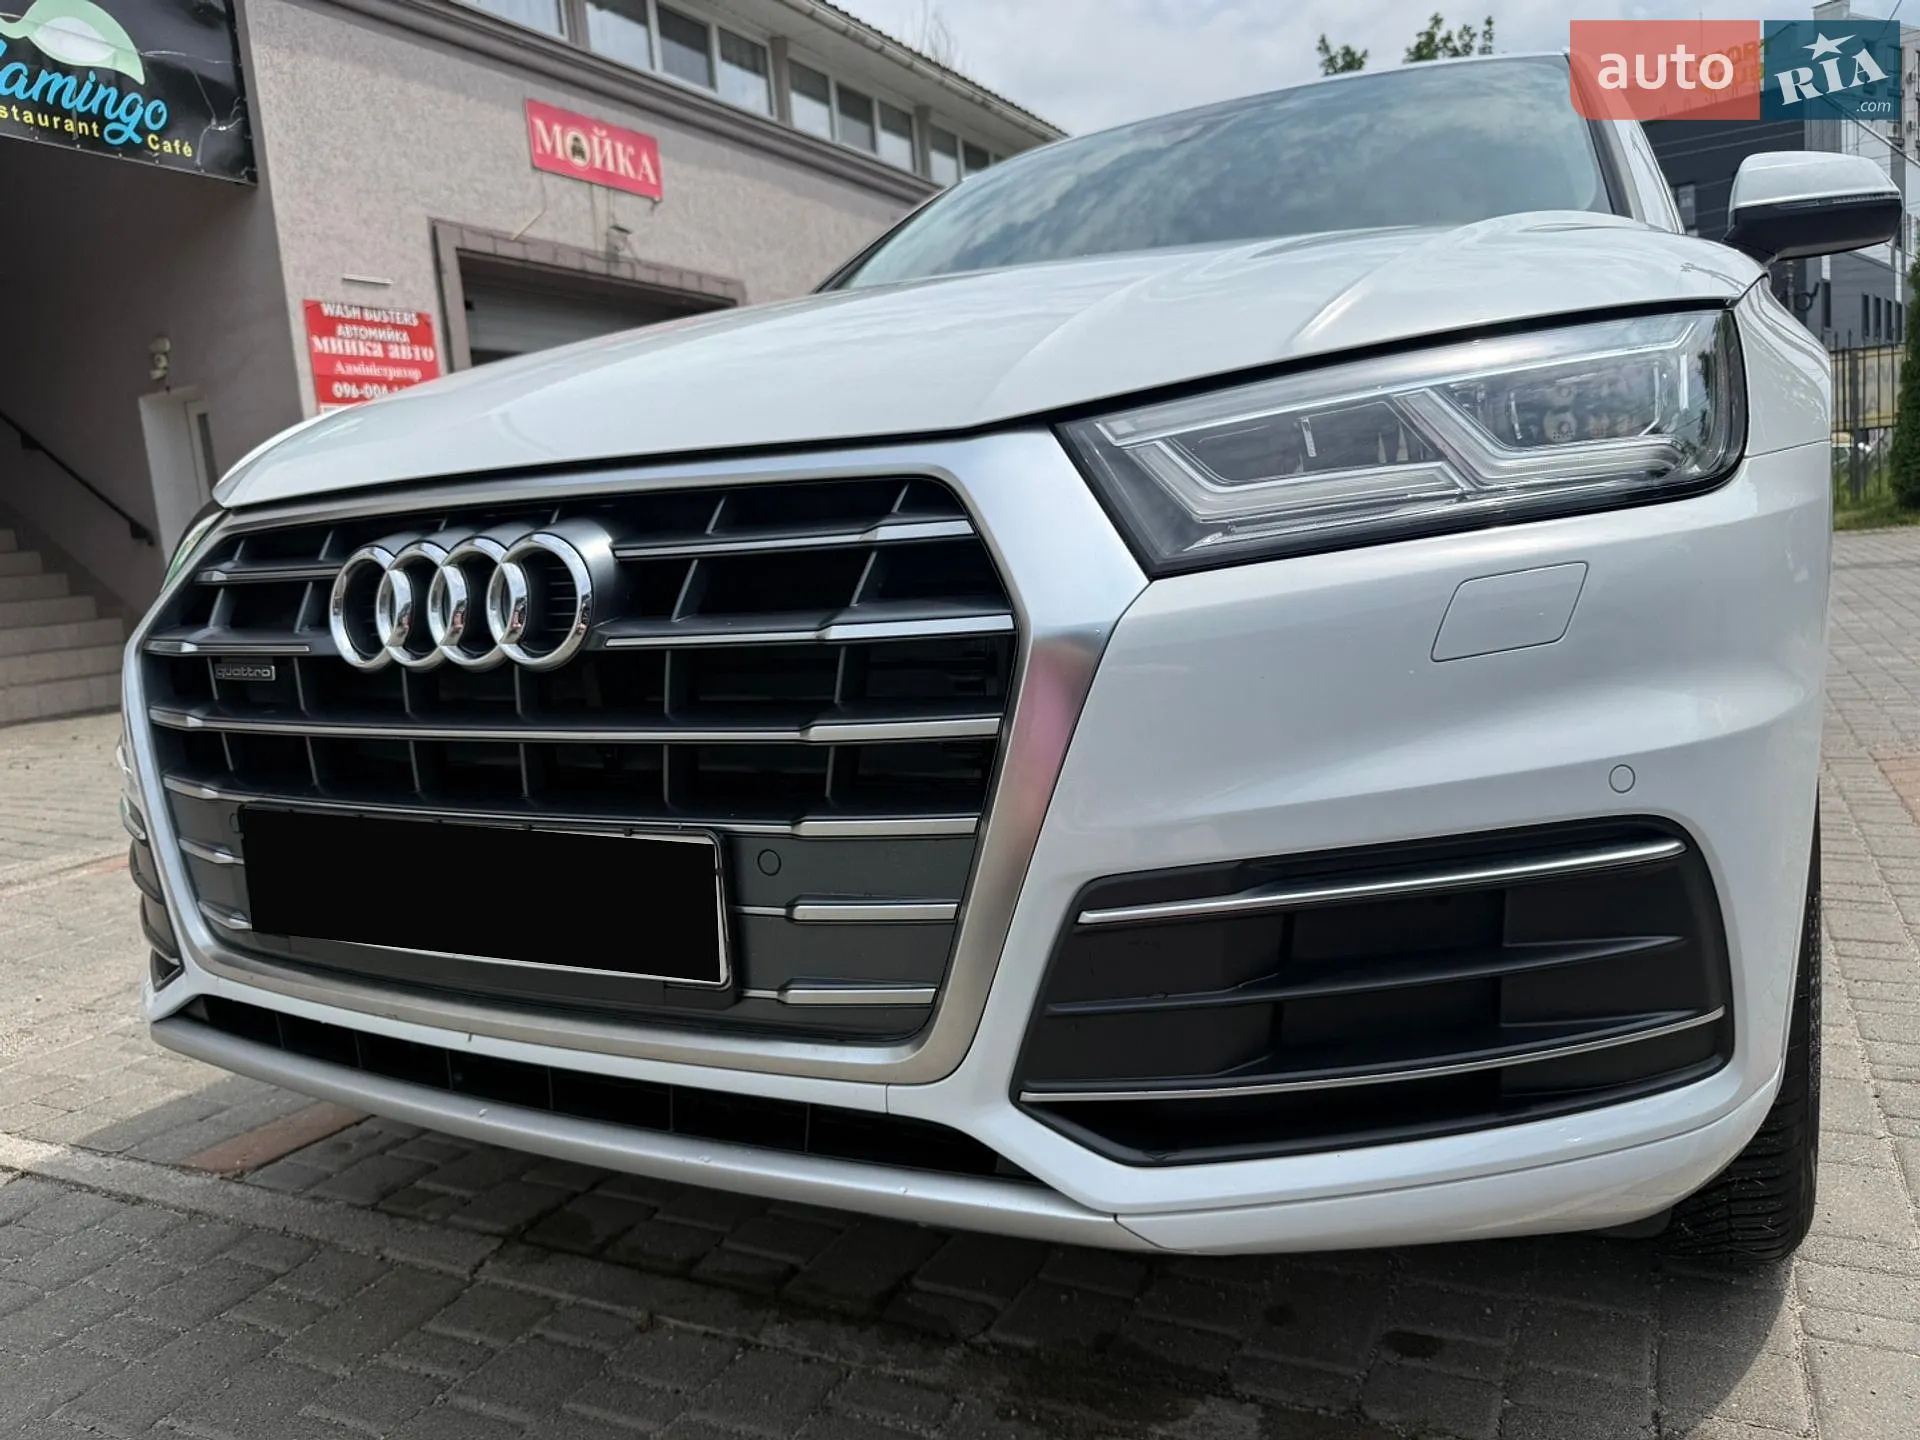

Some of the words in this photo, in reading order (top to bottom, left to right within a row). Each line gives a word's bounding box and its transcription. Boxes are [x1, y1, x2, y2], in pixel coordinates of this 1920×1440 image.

[0, 40, 167, 144] amingo
[147, 133, 193, 157] Café
[532, 116, 658, 185] МОЙКА
[321, 302, 361, 319] WASH
[363, 308, 419, 326] BUSTERS
[336, 324, 411, 343] АВТОМИЙКА
[216, 666, 271, 678] quattro
